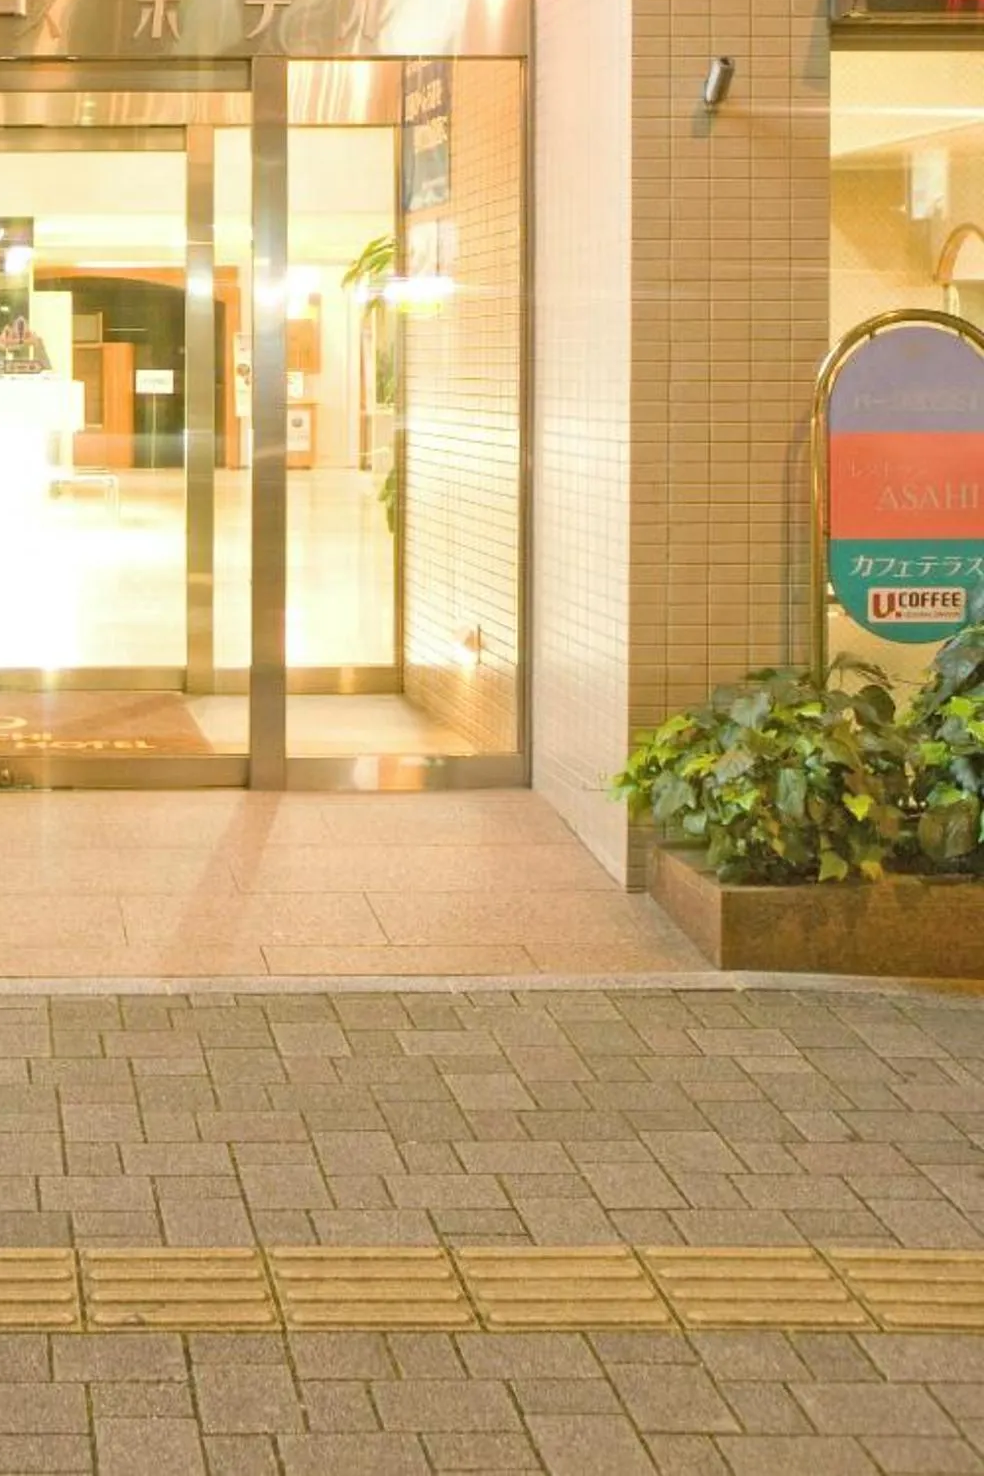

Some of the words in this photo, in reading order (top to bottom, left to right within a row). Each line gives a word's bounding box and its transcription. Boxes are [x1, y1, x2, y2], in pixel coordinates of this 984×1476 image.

[876, 481, 978, 511] ASAHI
[849, 554, 984, 578] カフェテラス
[899, 592, 961, 607] COFFEE
[14, 741, 156, 751] HOTEL
